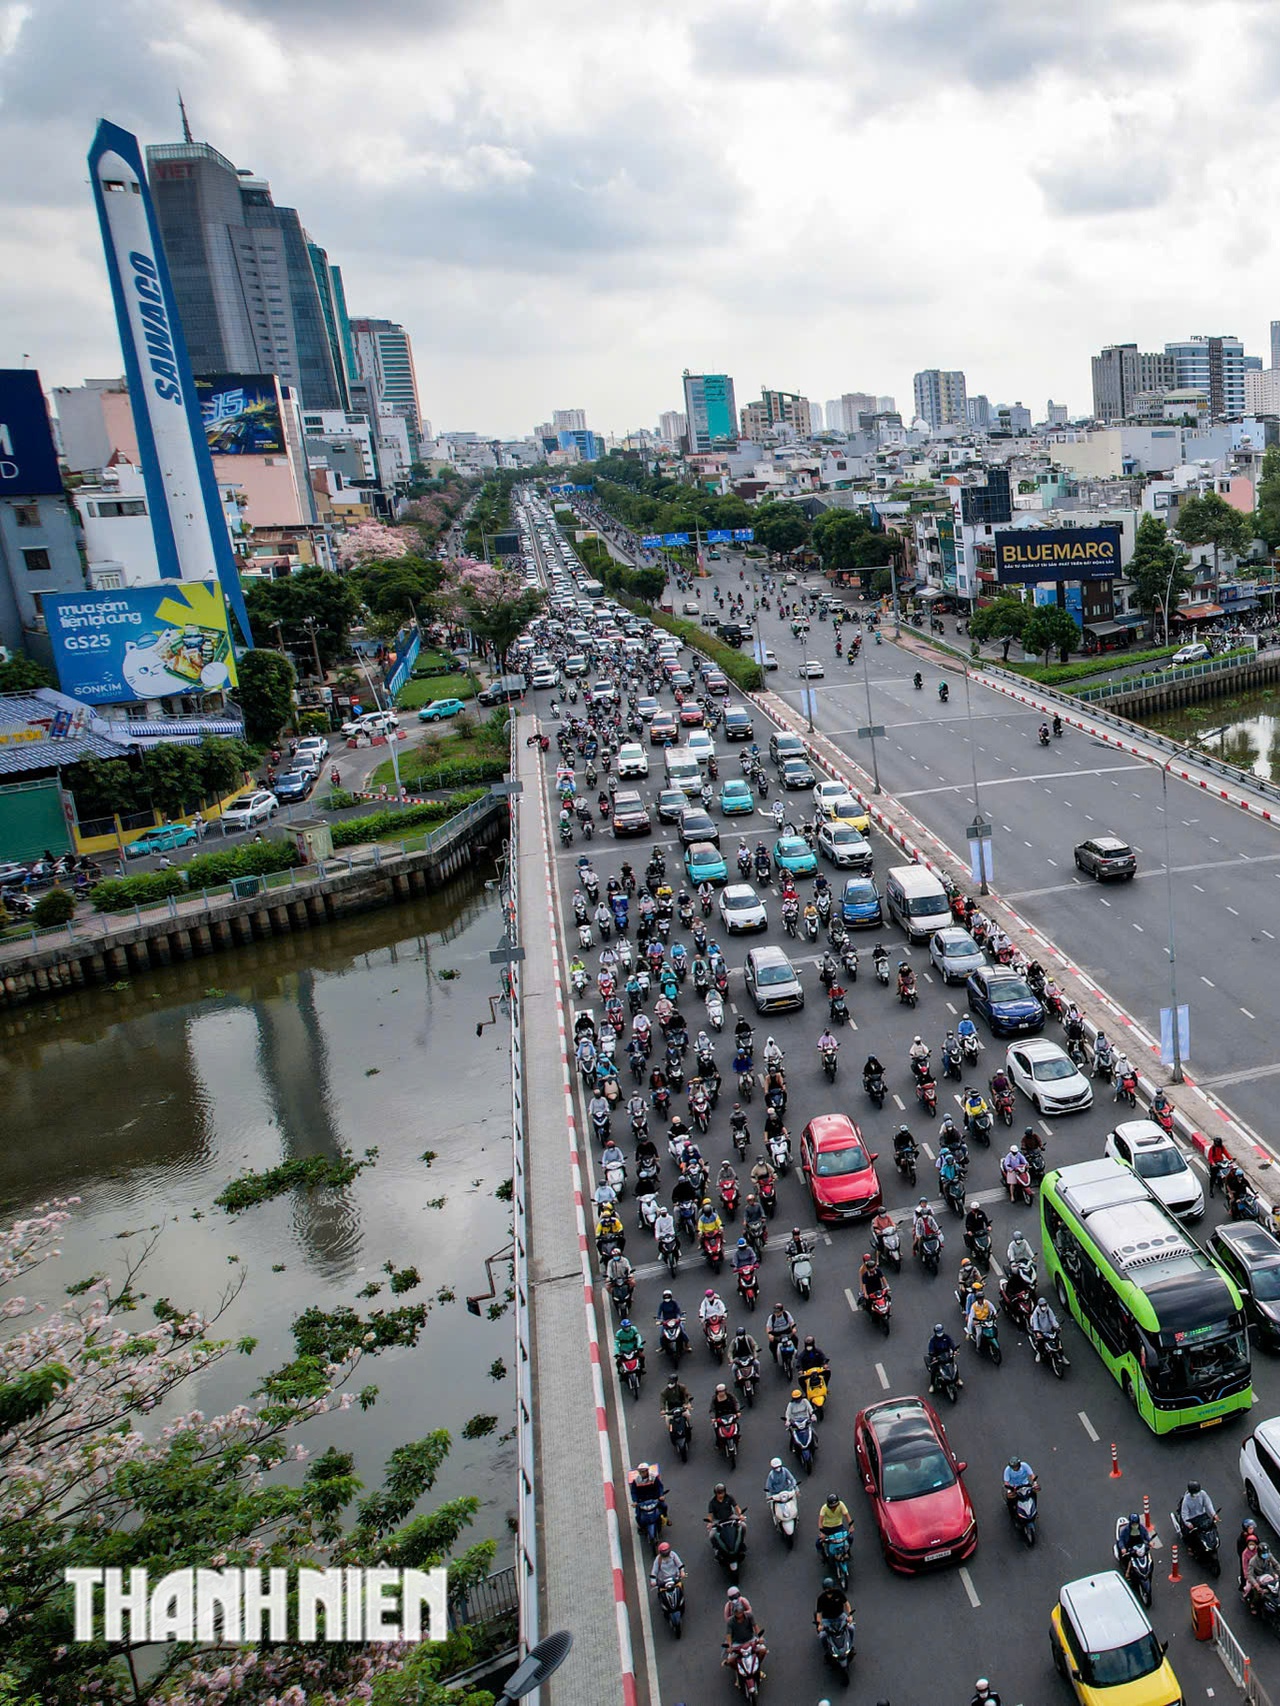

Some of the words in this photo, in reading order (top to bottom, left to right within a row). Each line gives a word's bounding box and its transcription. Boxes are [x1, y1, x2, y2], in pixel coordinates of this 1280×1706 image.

[129, 251, 183, 406] SAWACO
[1003, 541, 1114, 562] BLUEMARQ
[58, 604, 95, 615] mua
[96, 596, 129, 613] sắm
[106, 611, 142, 625] cùng
[64, 634, 111, 650] GS25
[74, 683, 122, 695] SONKIM
